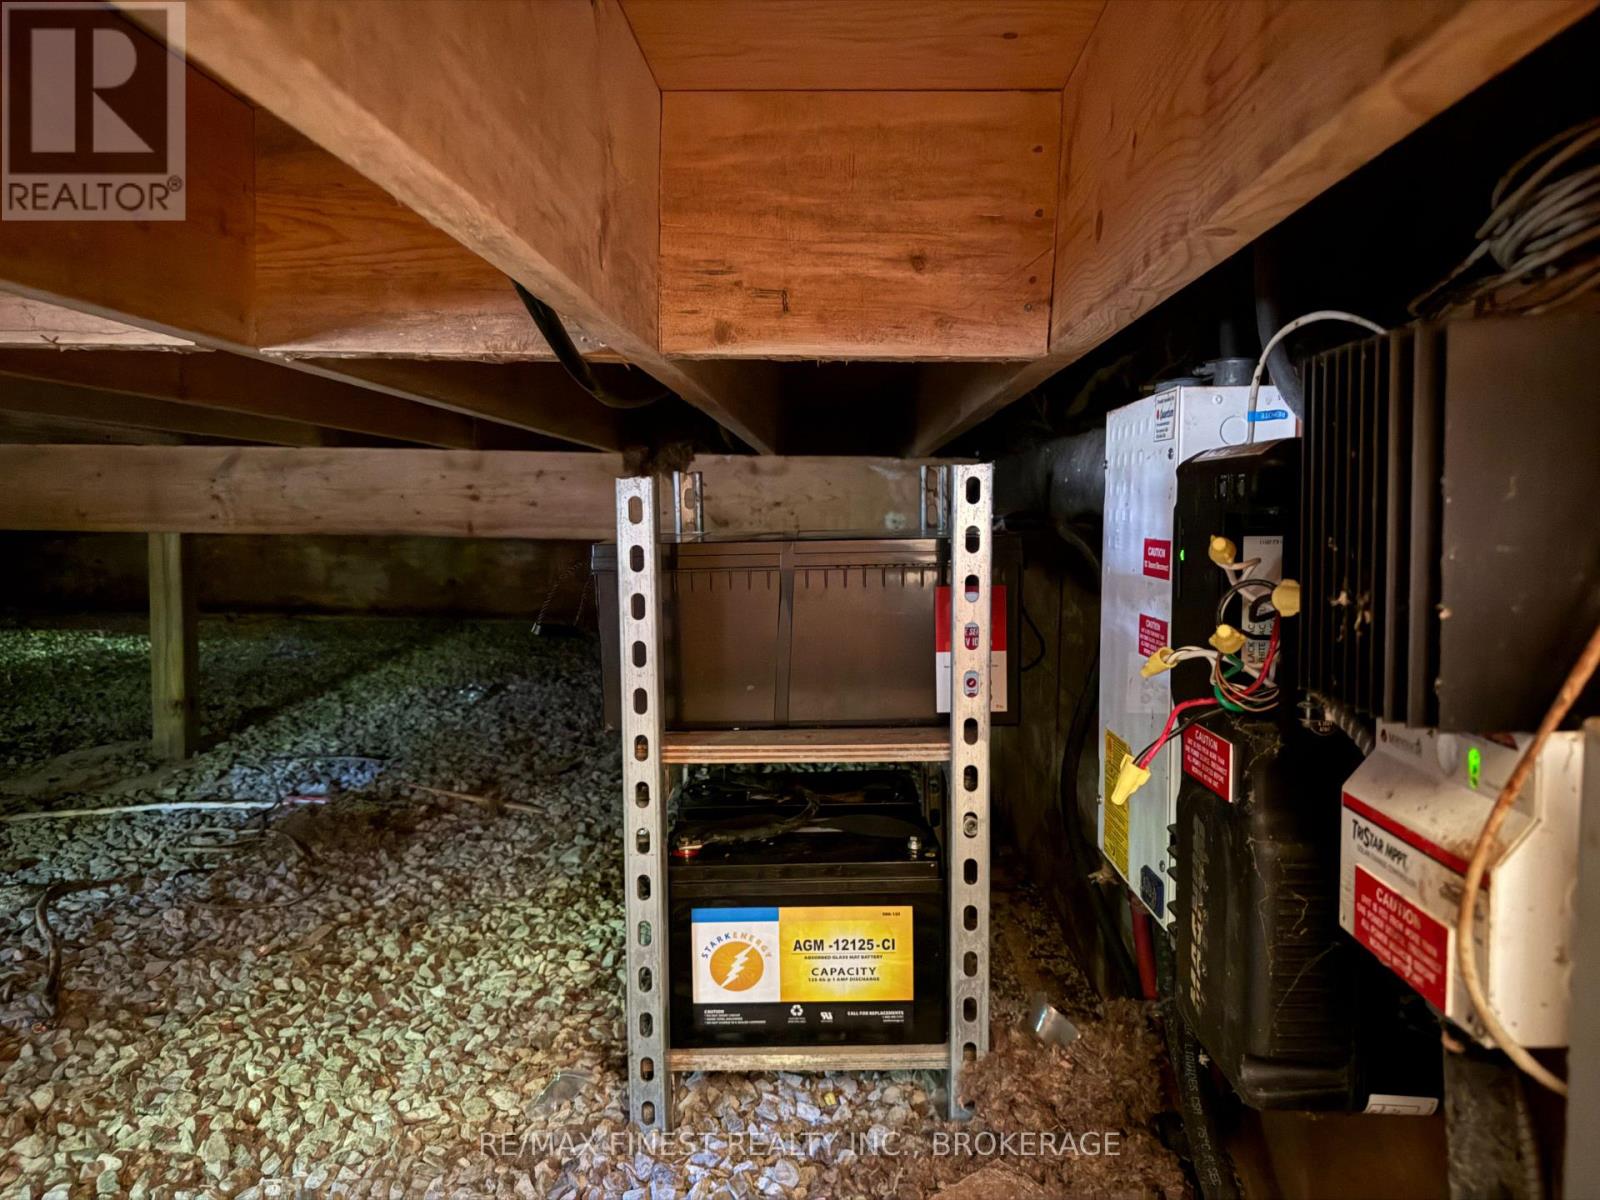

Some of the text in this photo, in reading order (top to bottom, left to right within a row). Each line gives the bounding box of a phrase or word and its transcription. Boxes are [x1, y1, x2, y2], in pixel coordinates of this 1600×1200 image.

[1195, 730, 1218, 752] CAUTION
[1375, 887, 1422, 930] CAUTION
[793, 939, 824, 952] AGM
[811, 967, 877, 976] CAPACITY
